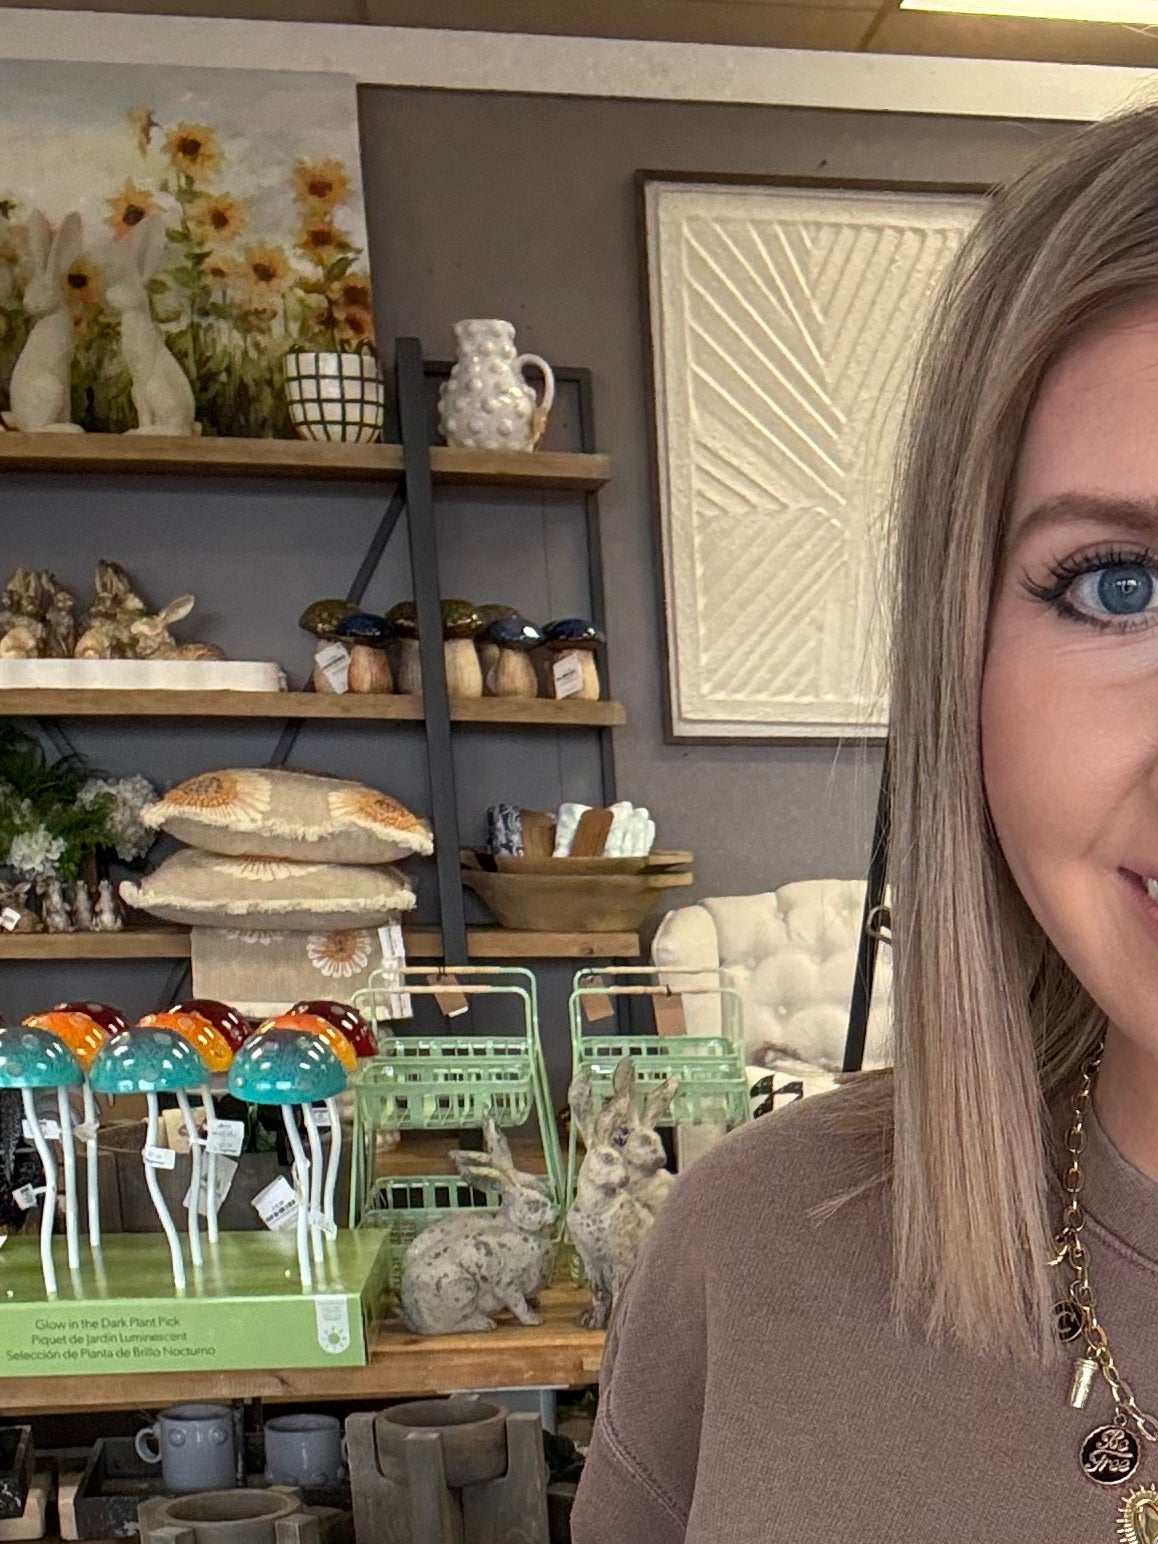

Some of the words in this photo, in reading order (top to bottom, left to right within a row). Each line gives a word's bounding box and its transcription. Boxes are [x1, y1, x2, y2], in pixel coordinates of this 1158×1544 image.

[35, 1319, 66, 1330] Glow
[68, 1319, 79, 1329] in
[81, 1318, 98, 1329] the
[101, 1318, 127, 1329] Dark
[129, 1317, 156, 1327] Plant
[159, 1316, 180, 1326] Pick
[32, 1334, 66, 1346] Piquet
[69, 1334, 84, 1344] de
[62, 1349, 77, 1360] de
[80, 1348, 113, 1359] Planta
[115, 1347, 131, 1358] de
[163, 1346, 216, 1357] Nocturno
[1096, 1429, 1129, 1452] Be
[1085, 1449, 1133, 1472] Free
